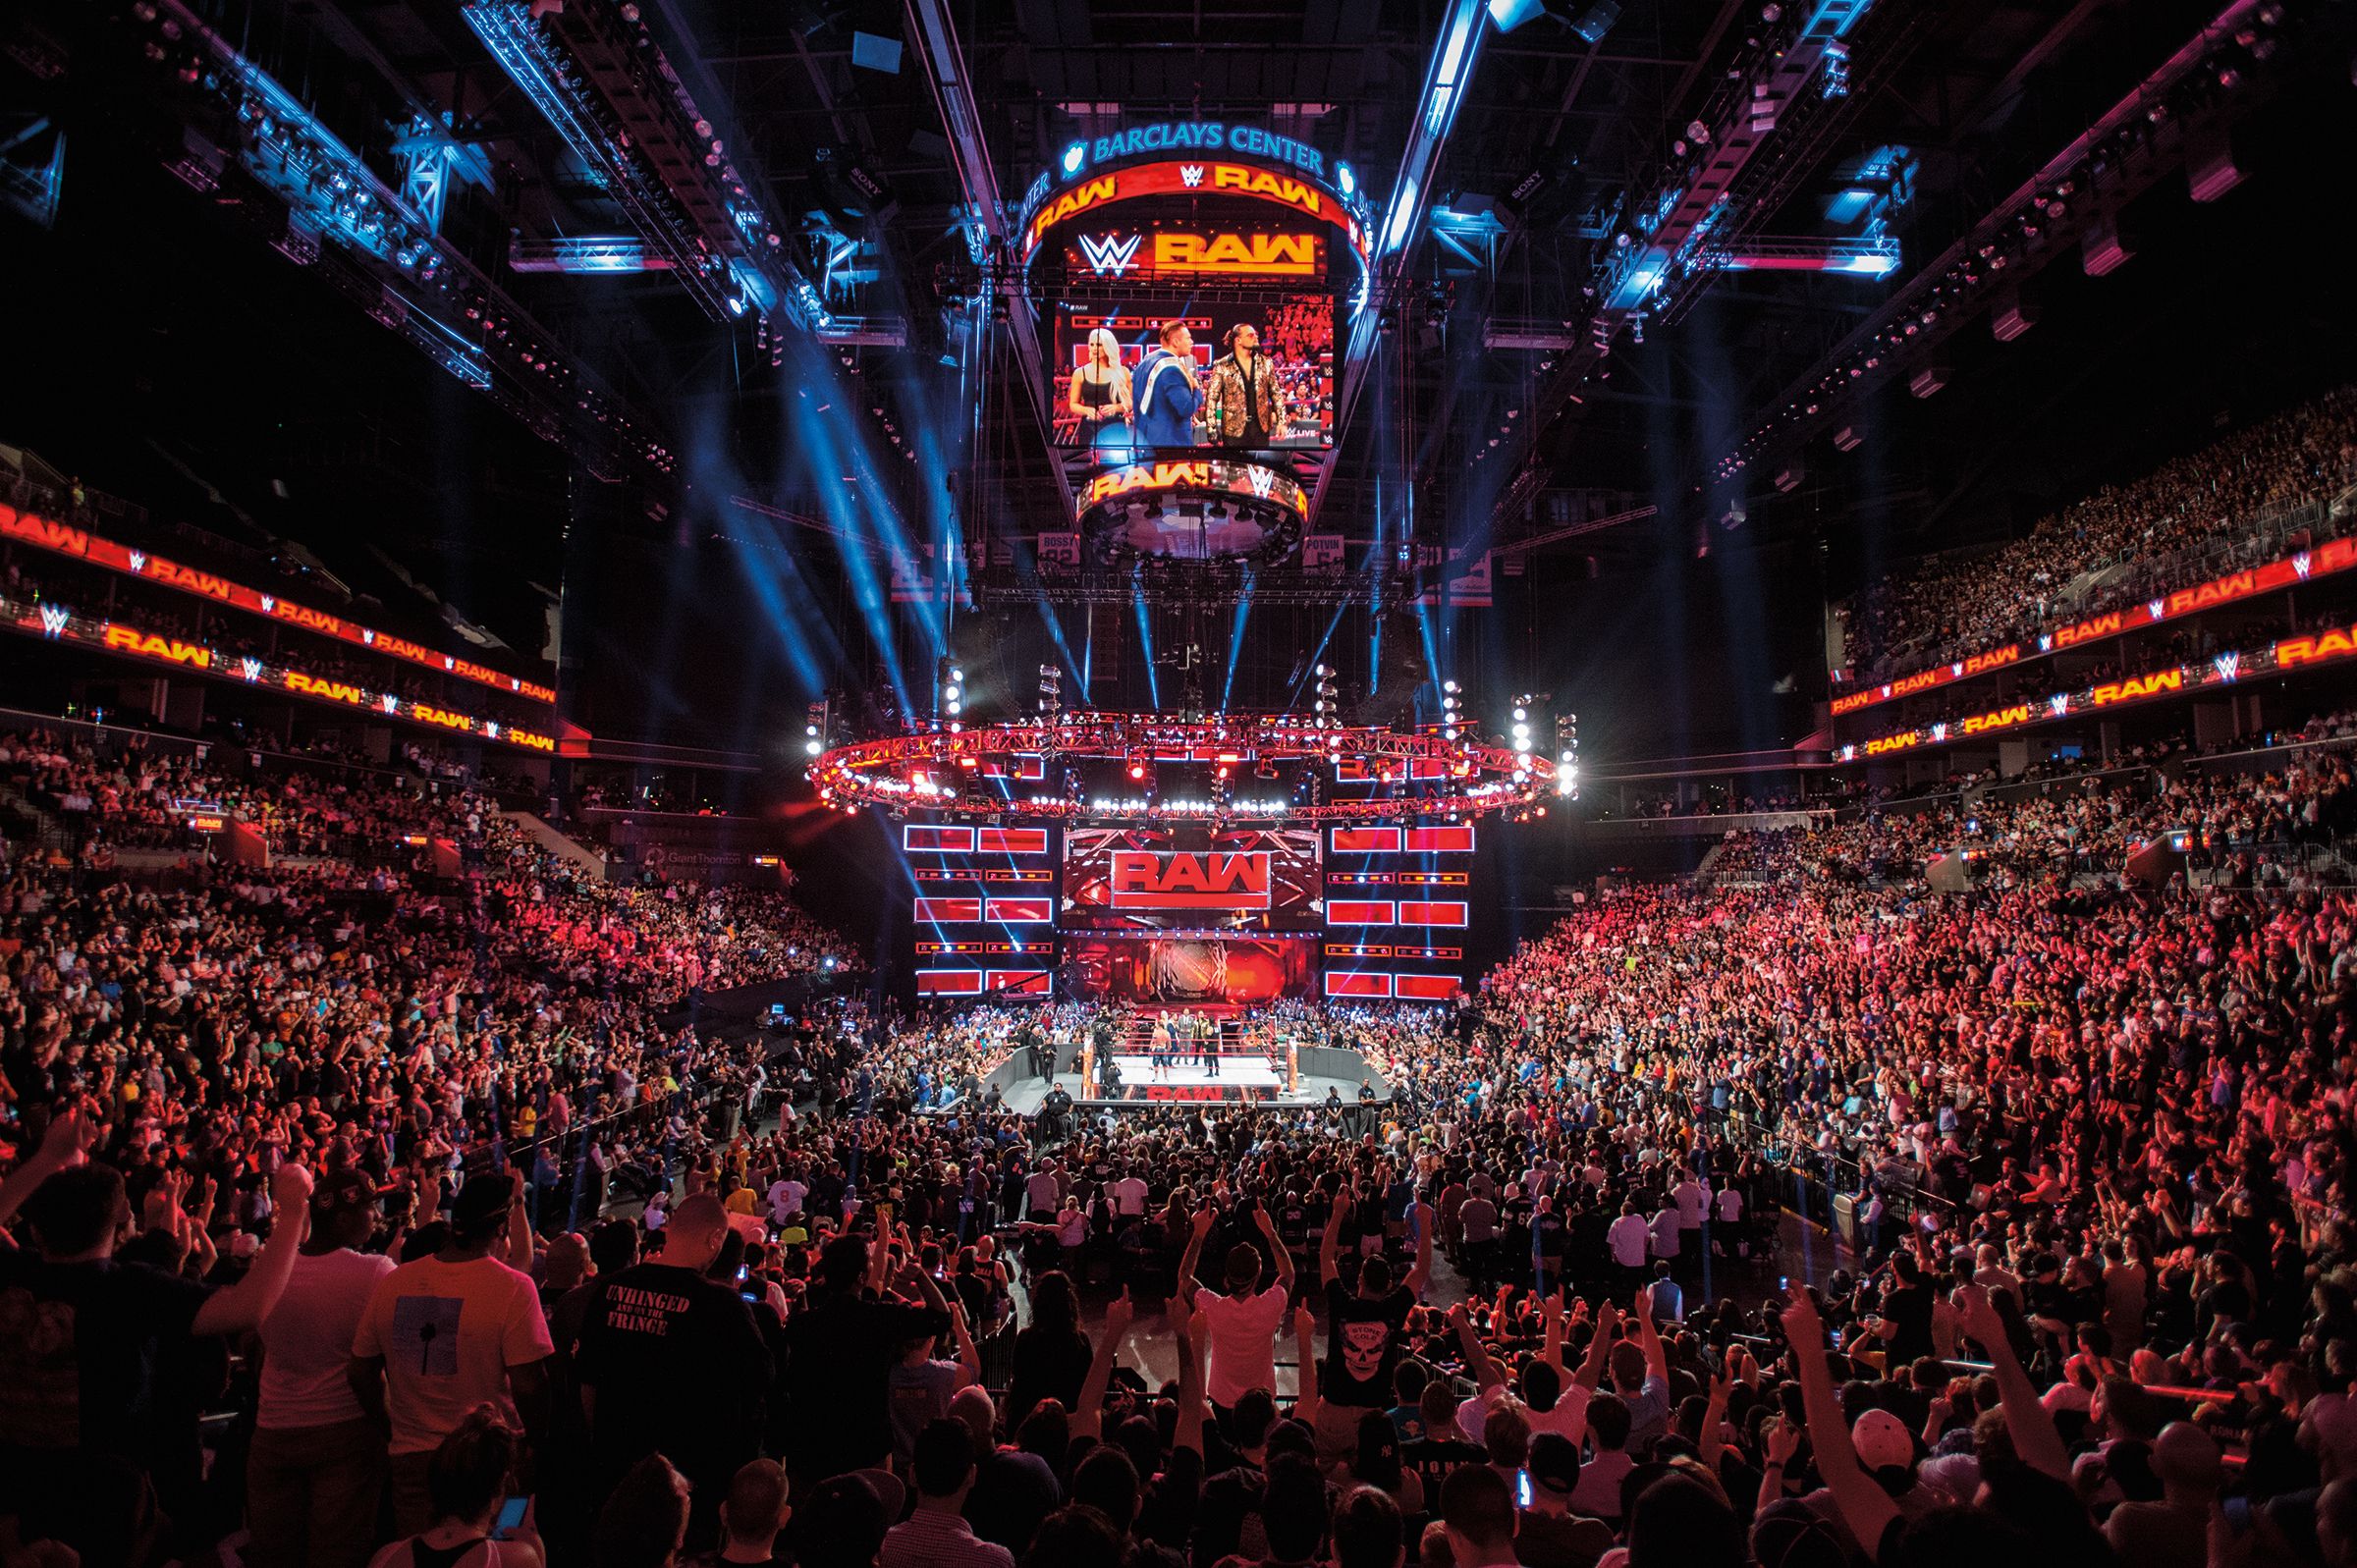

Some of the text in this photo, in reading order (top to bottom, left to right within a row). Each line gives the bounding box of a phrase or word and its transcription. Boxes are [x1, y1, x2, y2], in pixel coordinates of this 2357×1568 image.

[1094, 125, 1324, 176] BARCLAYS CENTER
[851, 167, 883, 194] SONY
[1036, 177, 1116, 239] RAW
[1215, 166, 1321, 213] RAW
[1155, 234, 1315, 264] RAW
[1296, 429, 1316, 438] LIVE
[1093, 462, 1210, 504] RAW
[150, 557, 230, 598] RAW
[277, 602, 339, 633] RAW
[375, 633, 427, 662] RAW
[455, 660, 496, 684] RAW
[521, 681, 557, 704] RAW
[1833, 691, 1869, 715] RAW
[1892, 672, 1936, 696] RAW
[1965, 644, 2018, 674] RAW
[2056, 611, 2121, 647] RAW
[2170, 571, 2254, 612] RAW
[105, 623, 210, 670] RAW
[286, 672, 361, 705] RAW
[413, 704, 470, 732] RAW
[510, 729, 555, 752] RAW
[1866, 732, 1915, 755] RAW
[1964, 705, 2029, 734] RAW
[2093, 669, 2183, 707] RAW
[2276, 622, 2357, 668] RA
[668, 852, 740, 865] Grant Thornton
[1115, 853, 1267, 892] RAW
[1146, 1086, 1223, 1101] RAW
[605, 1284, 690, 1313] UNHINGED
[616, 1303, 633, 1313] AND
[647, 1309, 665, 1319] THE
[607, 1311, 669, 1336] FRINGE
